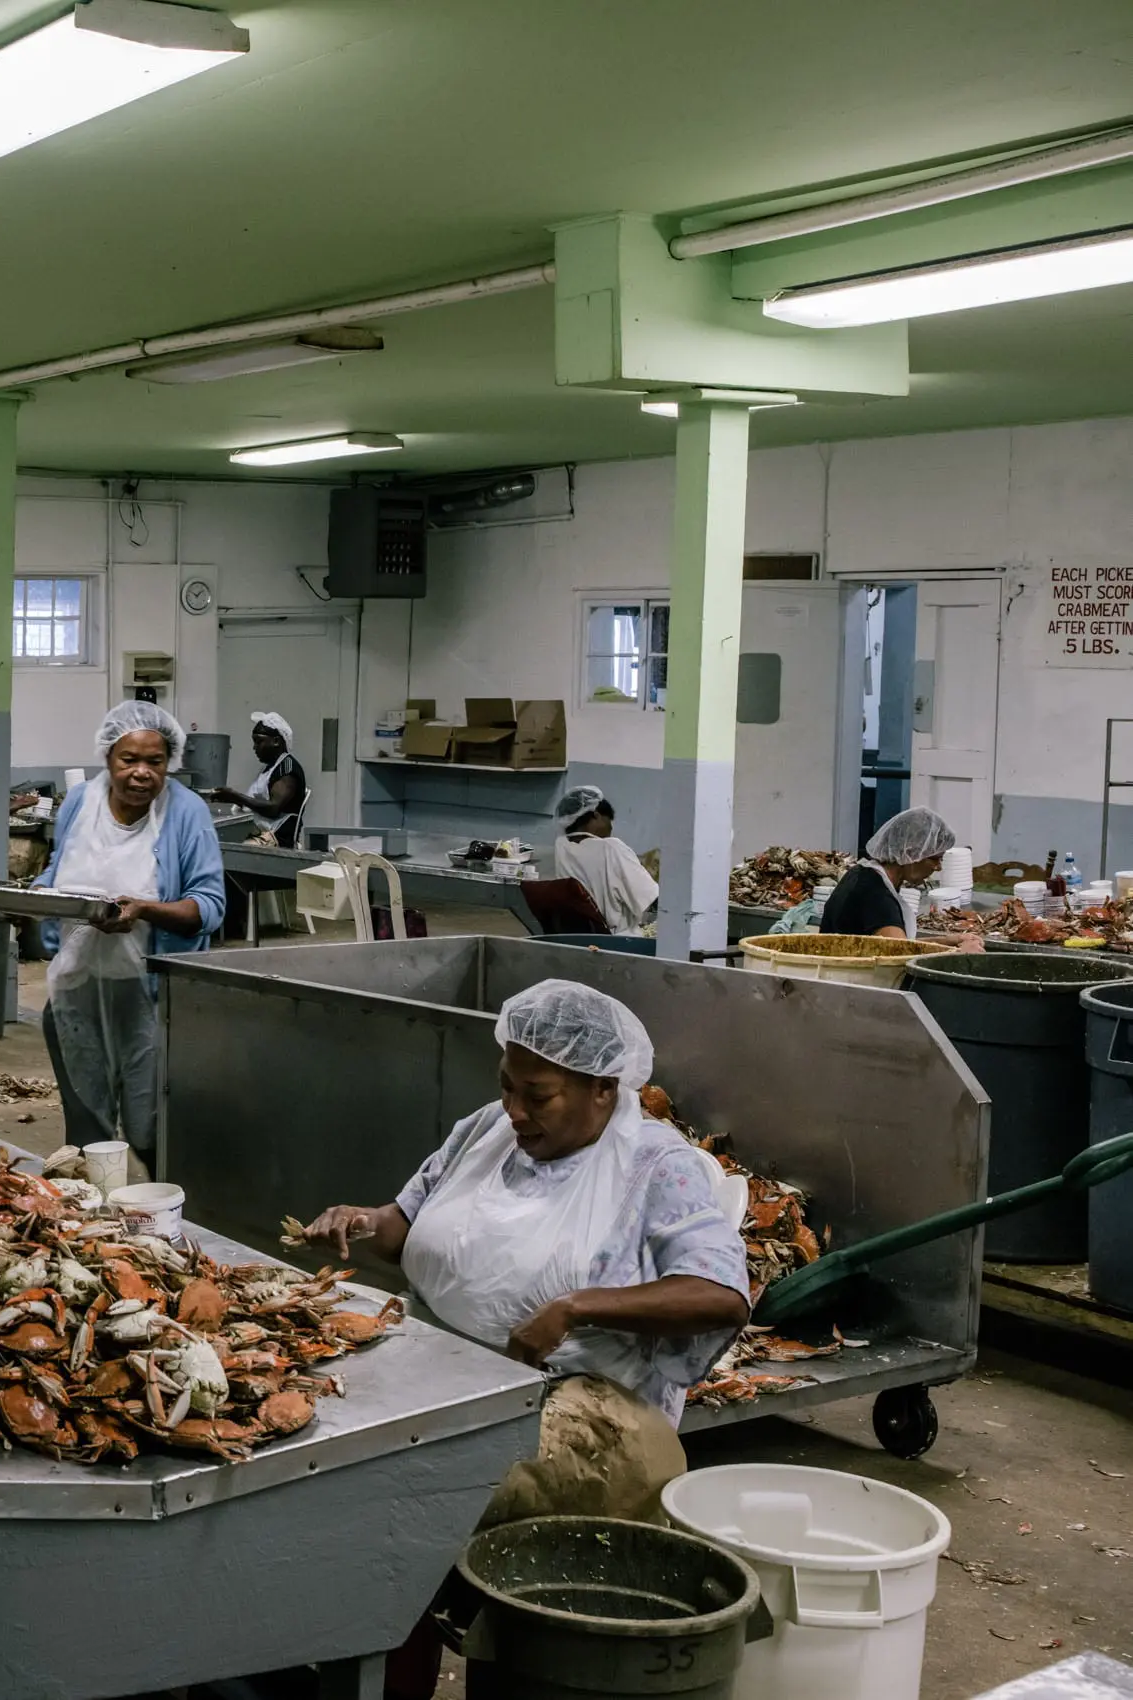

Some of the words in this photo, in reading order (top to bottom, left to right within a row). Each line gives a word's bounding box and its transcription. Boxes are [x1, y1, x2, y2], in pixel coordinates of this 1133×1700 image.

[1051, 567, 1088, 582] EACH
[1095, 567, 1133, 582] PICKE
[1053, 585, 1092, 600] MUST
[1057, 602, 1130, 617] CRABMEAT
[1047, 620, 1085, 634] AFTER
[1082, 638, 1120, 654] LBS.
[643, 1641, 703, 1675] 35
